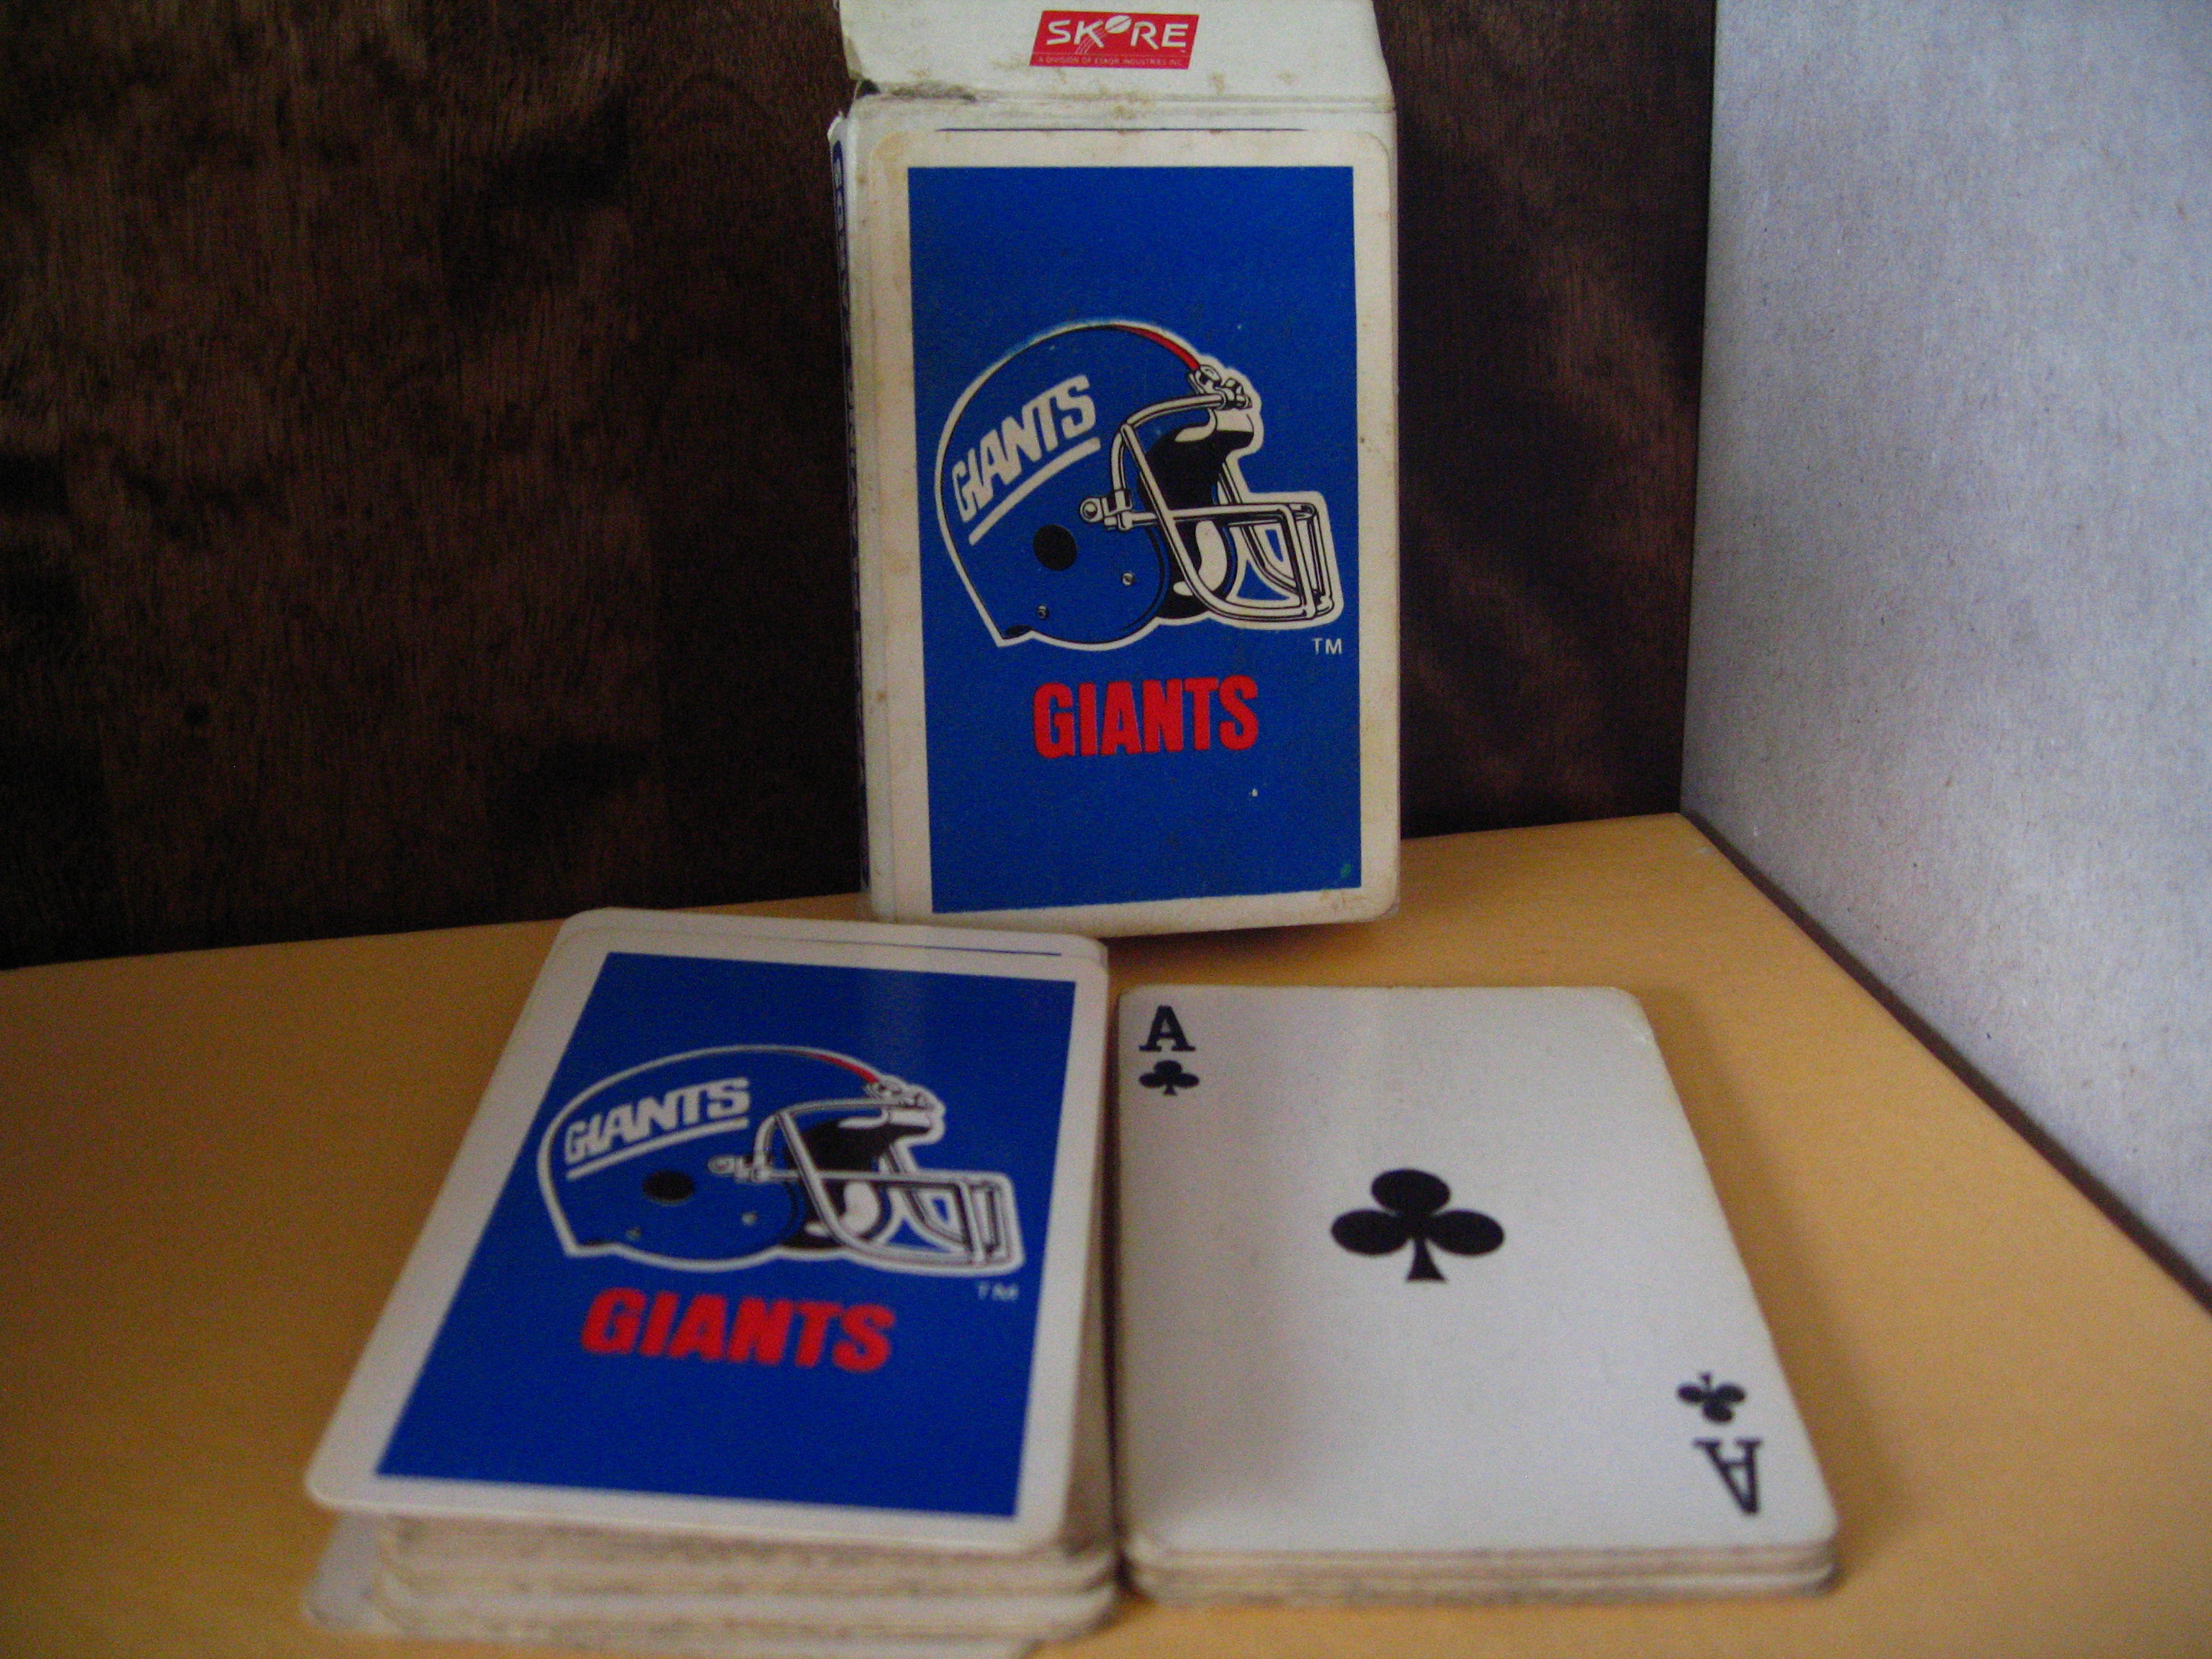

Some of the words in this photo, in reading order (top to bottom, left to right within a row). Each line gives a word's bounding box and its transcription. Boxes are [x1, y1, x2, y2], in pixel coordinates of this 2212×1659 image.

[952, 374, 1096, 523] GIANTS
[1312, 637, 1342, 655] TM
[1033, 675, 1259, 759] GIANTS
[1138, 1005, 1196, 1051] A
[564, 1076, 750, 1164] GIANTS
[580, 1286, 896, 1372] GIANTS
[976, 1281, 1020, 1303] TM
[1692, 1436, 1763, 1516] A
